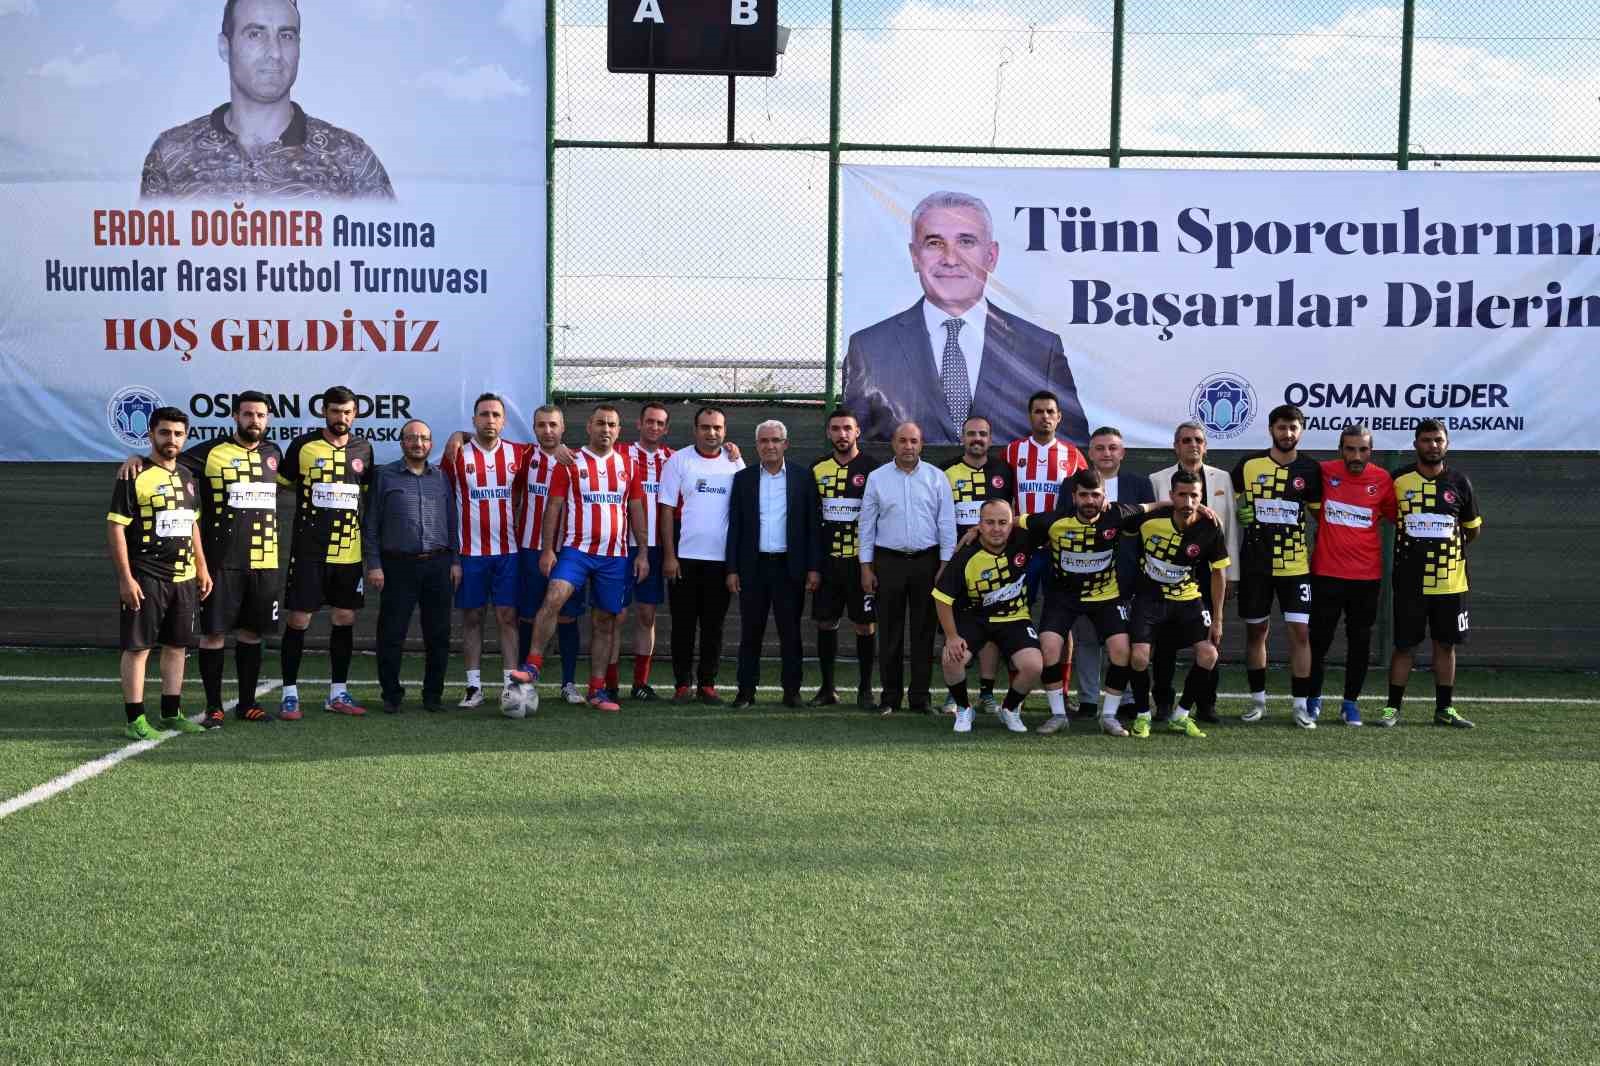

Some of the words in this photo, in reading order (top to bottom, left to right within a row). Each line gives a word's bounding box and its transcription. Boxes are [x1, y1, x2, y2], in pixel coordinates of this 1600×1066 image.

[632, 0, 664, 23] A
[730, 0, 759, 25] B
[94, 209, 181, 247] ERDAL
[191, 202, 323, 248] DOĞANER
[332, 215, 436, 248] Anısına
[1014, 206, 1160, 252] Tüm
[1177, 206, 1600, 268] Sporcularımı
[46, 260, 168, 292] Kurumlar
[177, 260, 246, 293] Arası
[256, 261, 341, 294] Futbol
[350, 262, 488, 295] Turnuvası
[1069, 279, 1368, 341] Başarılar
[104, 319, 199, 361] HOŞ
[210, 309, 440, 353] GELDİNİZ
[190, 393, 300, 418] OSAN
[308, 394, 412, 419] GDER
[1284, 382, 1397, 408] OSMAN
[1405, 383, 1510, 408] GÜDER
[1372, 416, 1446, 431] BELED
[1299, 583, 1312, 602] 3
[271, 601, 279, 620] 2
